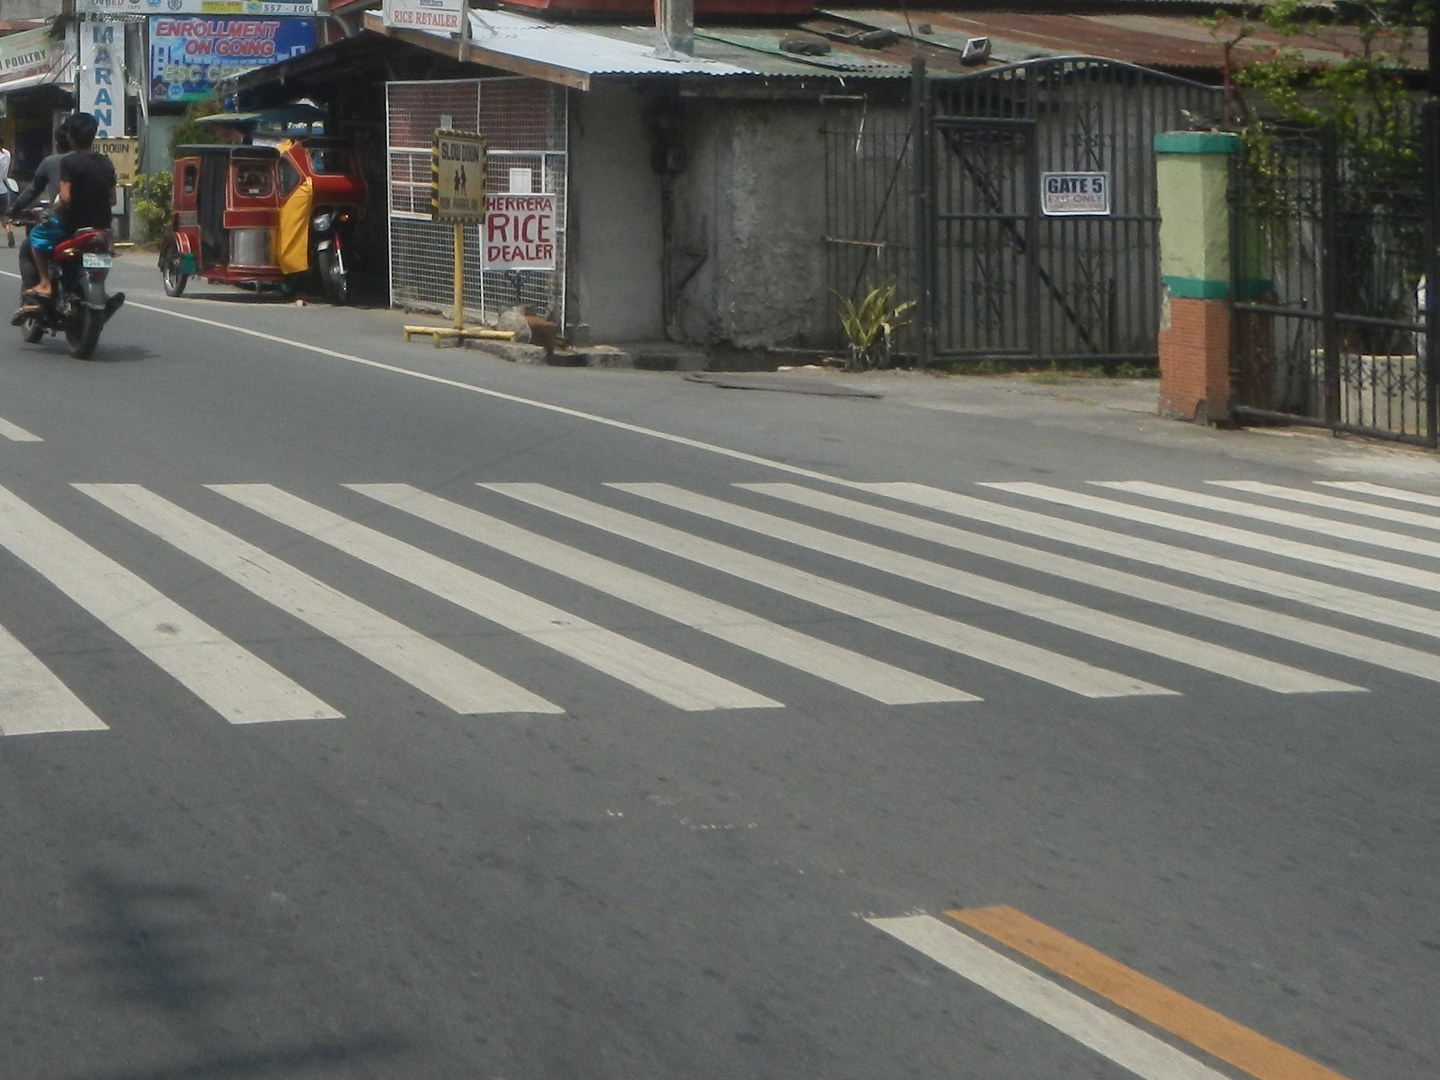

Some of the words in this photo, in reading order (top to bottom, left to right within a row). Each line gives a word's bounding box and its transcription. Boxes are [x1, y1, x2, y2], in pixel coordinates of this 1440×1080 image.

[264, 4, 281, 12] 557
[394, 11, 413, 23] RICE
[416, 13, 458, 28] RETAILER
[155, 21, 280, 38] ENROLLMENT
[185, 39, 211, 56] ON
[215, 39, 276, 57] GOING
[5, 50, 47, 69] POULTRY
[162, 65, 200, 83] ESC
[103, 144, 129, 153] DOWN
[1048, 178, 1088, 194] GATE
[1092, 178, 1102, 193] 5
[486, 197, 553, 211] HERRERA
[487, 214, 551, 243] RICE
[487, 245, 553, 262] DEALER
